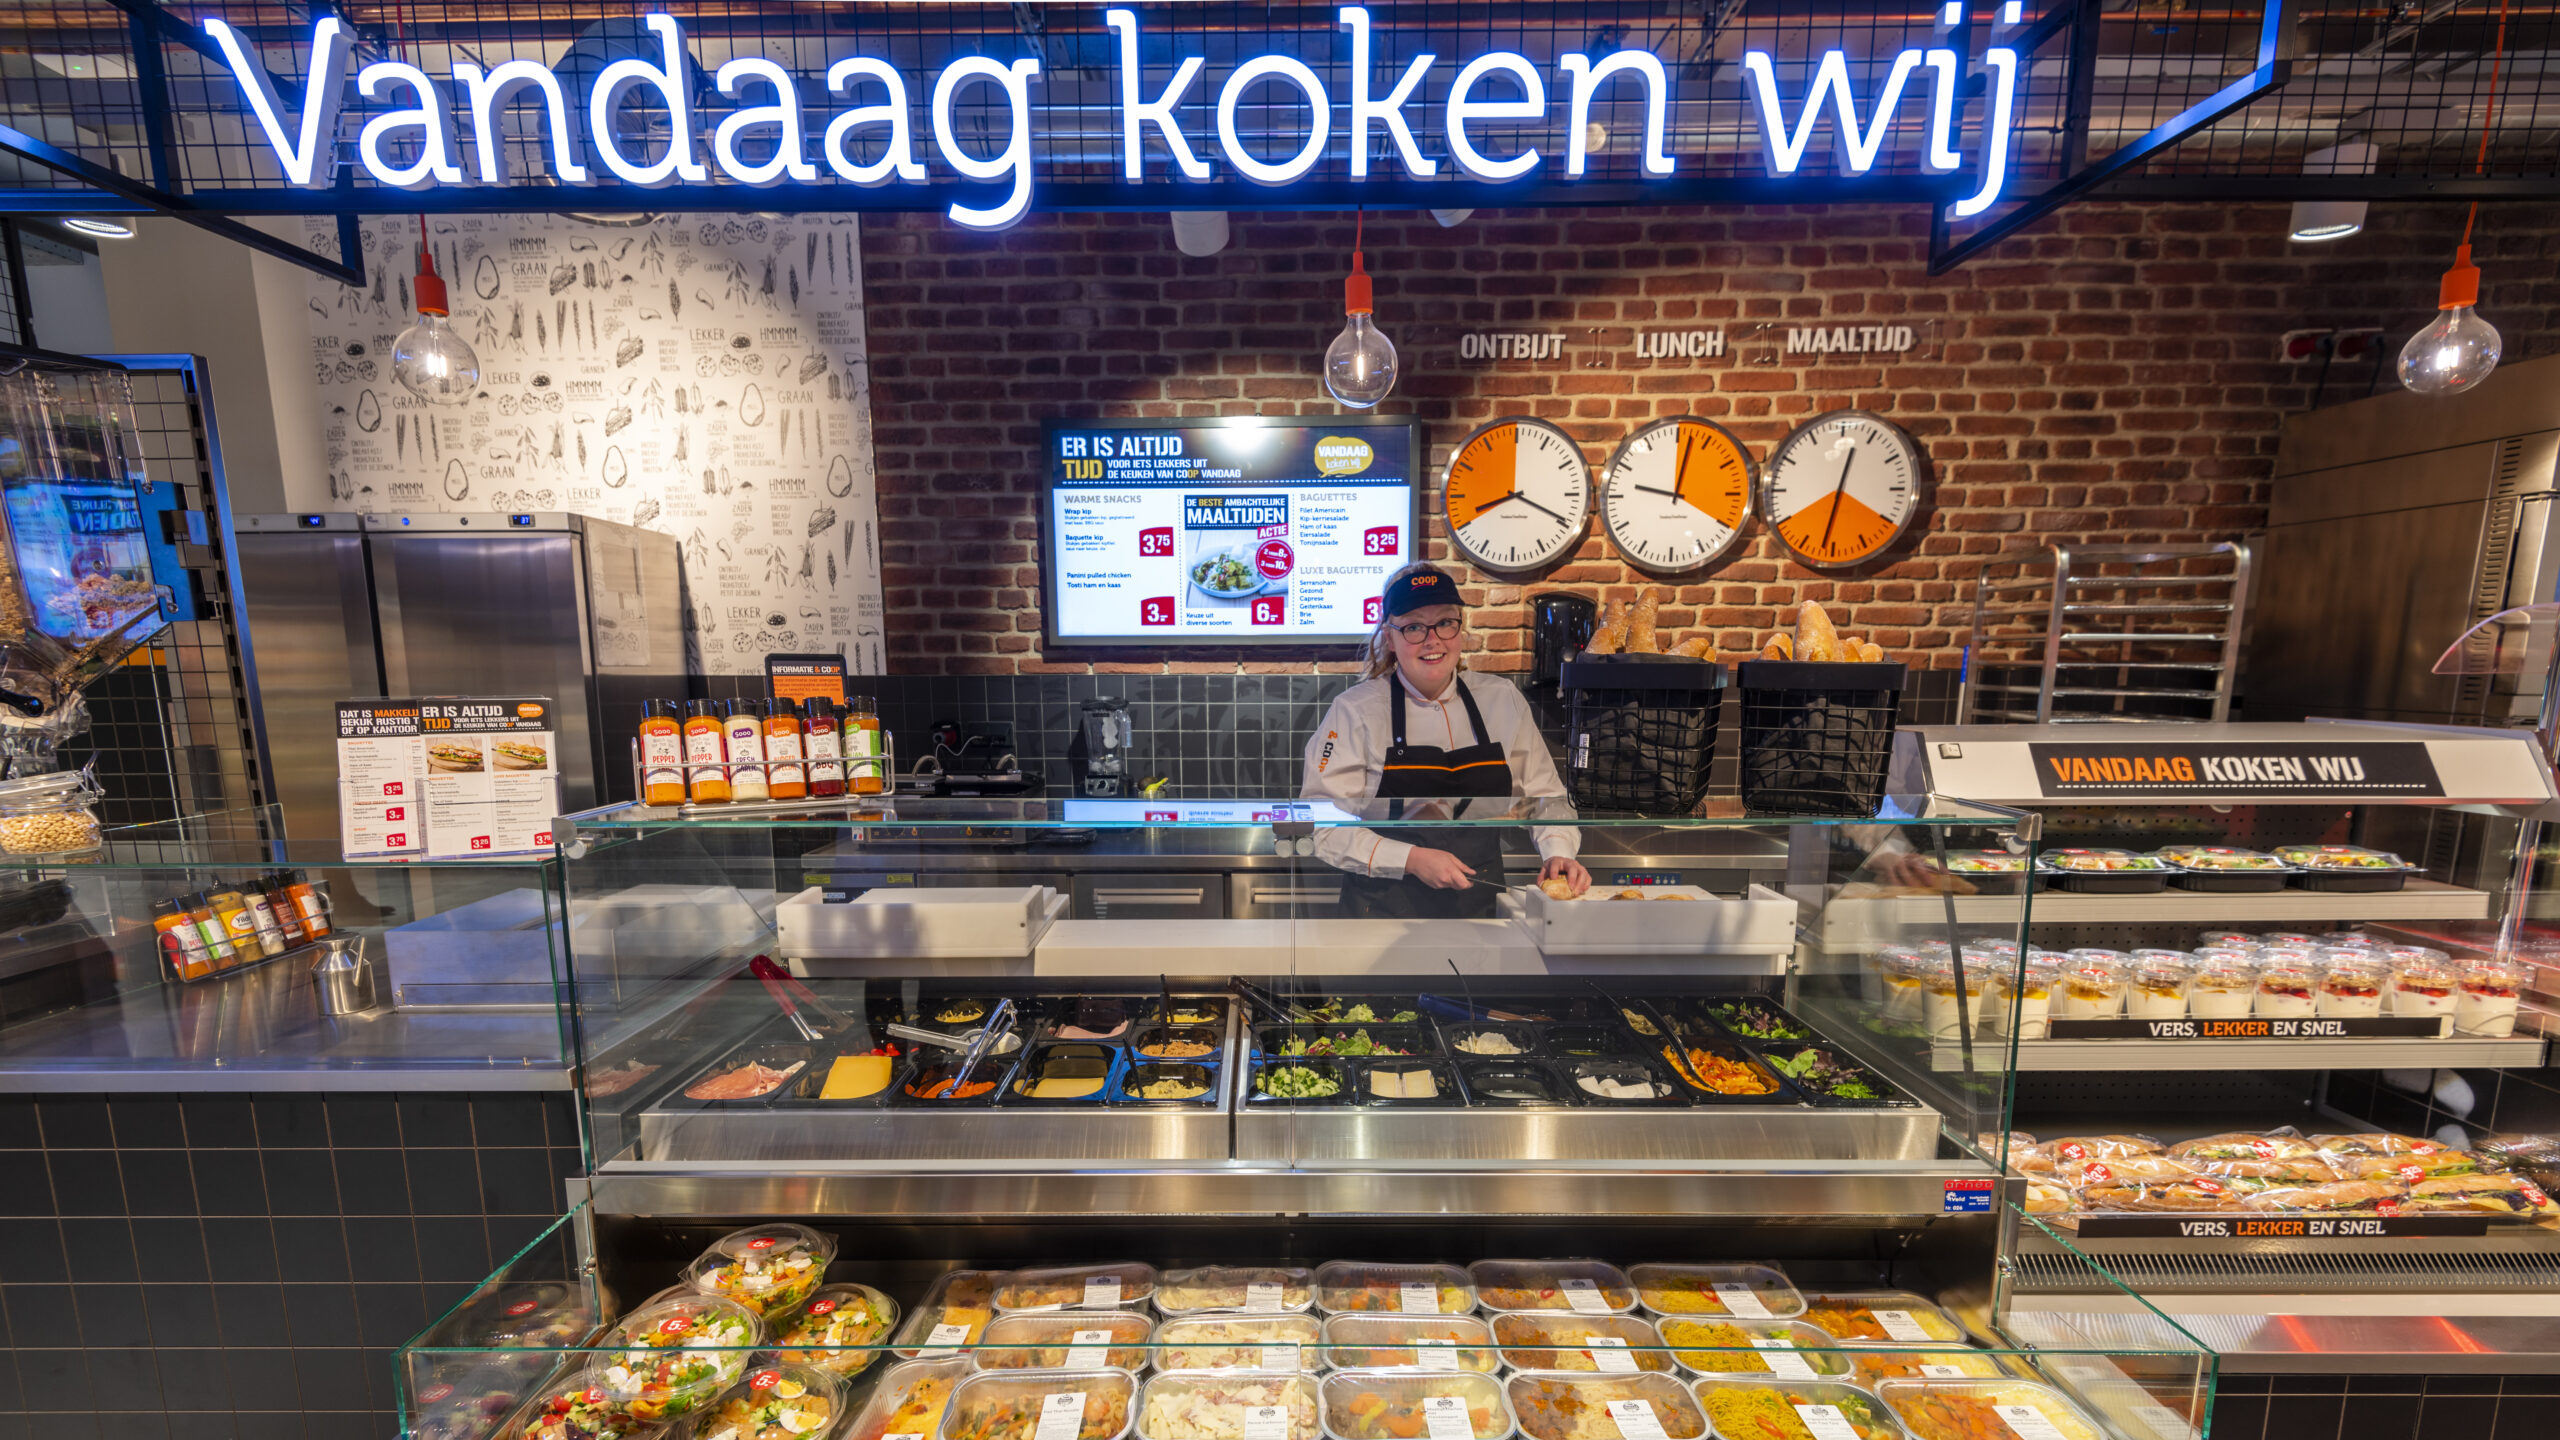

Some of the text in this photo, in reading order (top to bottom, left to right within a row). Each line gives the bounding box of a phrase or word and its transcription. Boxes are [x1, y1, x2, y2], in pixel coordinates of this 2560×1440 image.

[204, 2, 2022, 229] Vandaag koken wij
[509, 237, 547, 251] HMMMM
[512, 263, 547, 275] GRAAN
[690, 328, 725, 341] LEKKER
[760, 328, 797, 340] HMMMM
[1787, 326, 1913, 354] MAALTIJD
[1461, 334, 1566, 360] ONTBIJT
[1637, 331, 1724, 358] LUNCH
[486, 373, 521, 385] LEKKER
[565, 381, 603, 393] HMMMM
[393, 396, 428, 409] GRAAN
[778, 391, 813, 403] GRAAN
[1061, 436, 1183, 457] ER IS ALTIJD
[1318, 446, 1369, 457] VANDAAG
[1061, 459, 1103, 479] TIJD
[1107, 458, 1208, 468] VOOR IETS LEKKERS UIT
[480, 466, 516, 479] GRAAN
[1108, 469, 1242, 479] DE KEUKEN VAN COOP VANDAAG
[388, 483, 424, 495] HMMMM
[769, 479, 806, 491] HMMMM
[566, 488, 601, 500] LEKKER
[1064, 495, 1142, 504] WARME SNACKS
[1300, 493, 1358, 502] BAGUETTES
[1186, 498, 1196, 506] DE
[1198, 498, 1223, 506] BESTE
[1186, 508, 1286, 524] MAALTIJDEN
[1259, 525, 1287, 538] ACTIE
[1142, 534, 1171, 554] 3.75
[1366, 533, 1396, 553] 3.25
[1300, 566, 1384, 575] LUXE BAGUETTES
[1411, 576, 1438, 586] coop
[727, 607, 761, 619] LEKKER
[340, 710, 359, 718] DAT
[362, 710, 372, 718] IS
[422, 705, 503, 718] ER IS ALTIJD
[376, 717, 410, 726] RUSTIG
[422, 718, 451, 730] TIJD
[342, 725, 418, 735] OF OP KANTOOR
[1318, 742, 1334, 772] COOP
[2050, 756, 2366, 783] VANDAAG KOKEN WIJ
[2149, 1021, 2347, 1039] VERS, LEKKER EN SNEL
[2180, 1220, 2386, 1238] VERS, LEKKER EN SNEL
